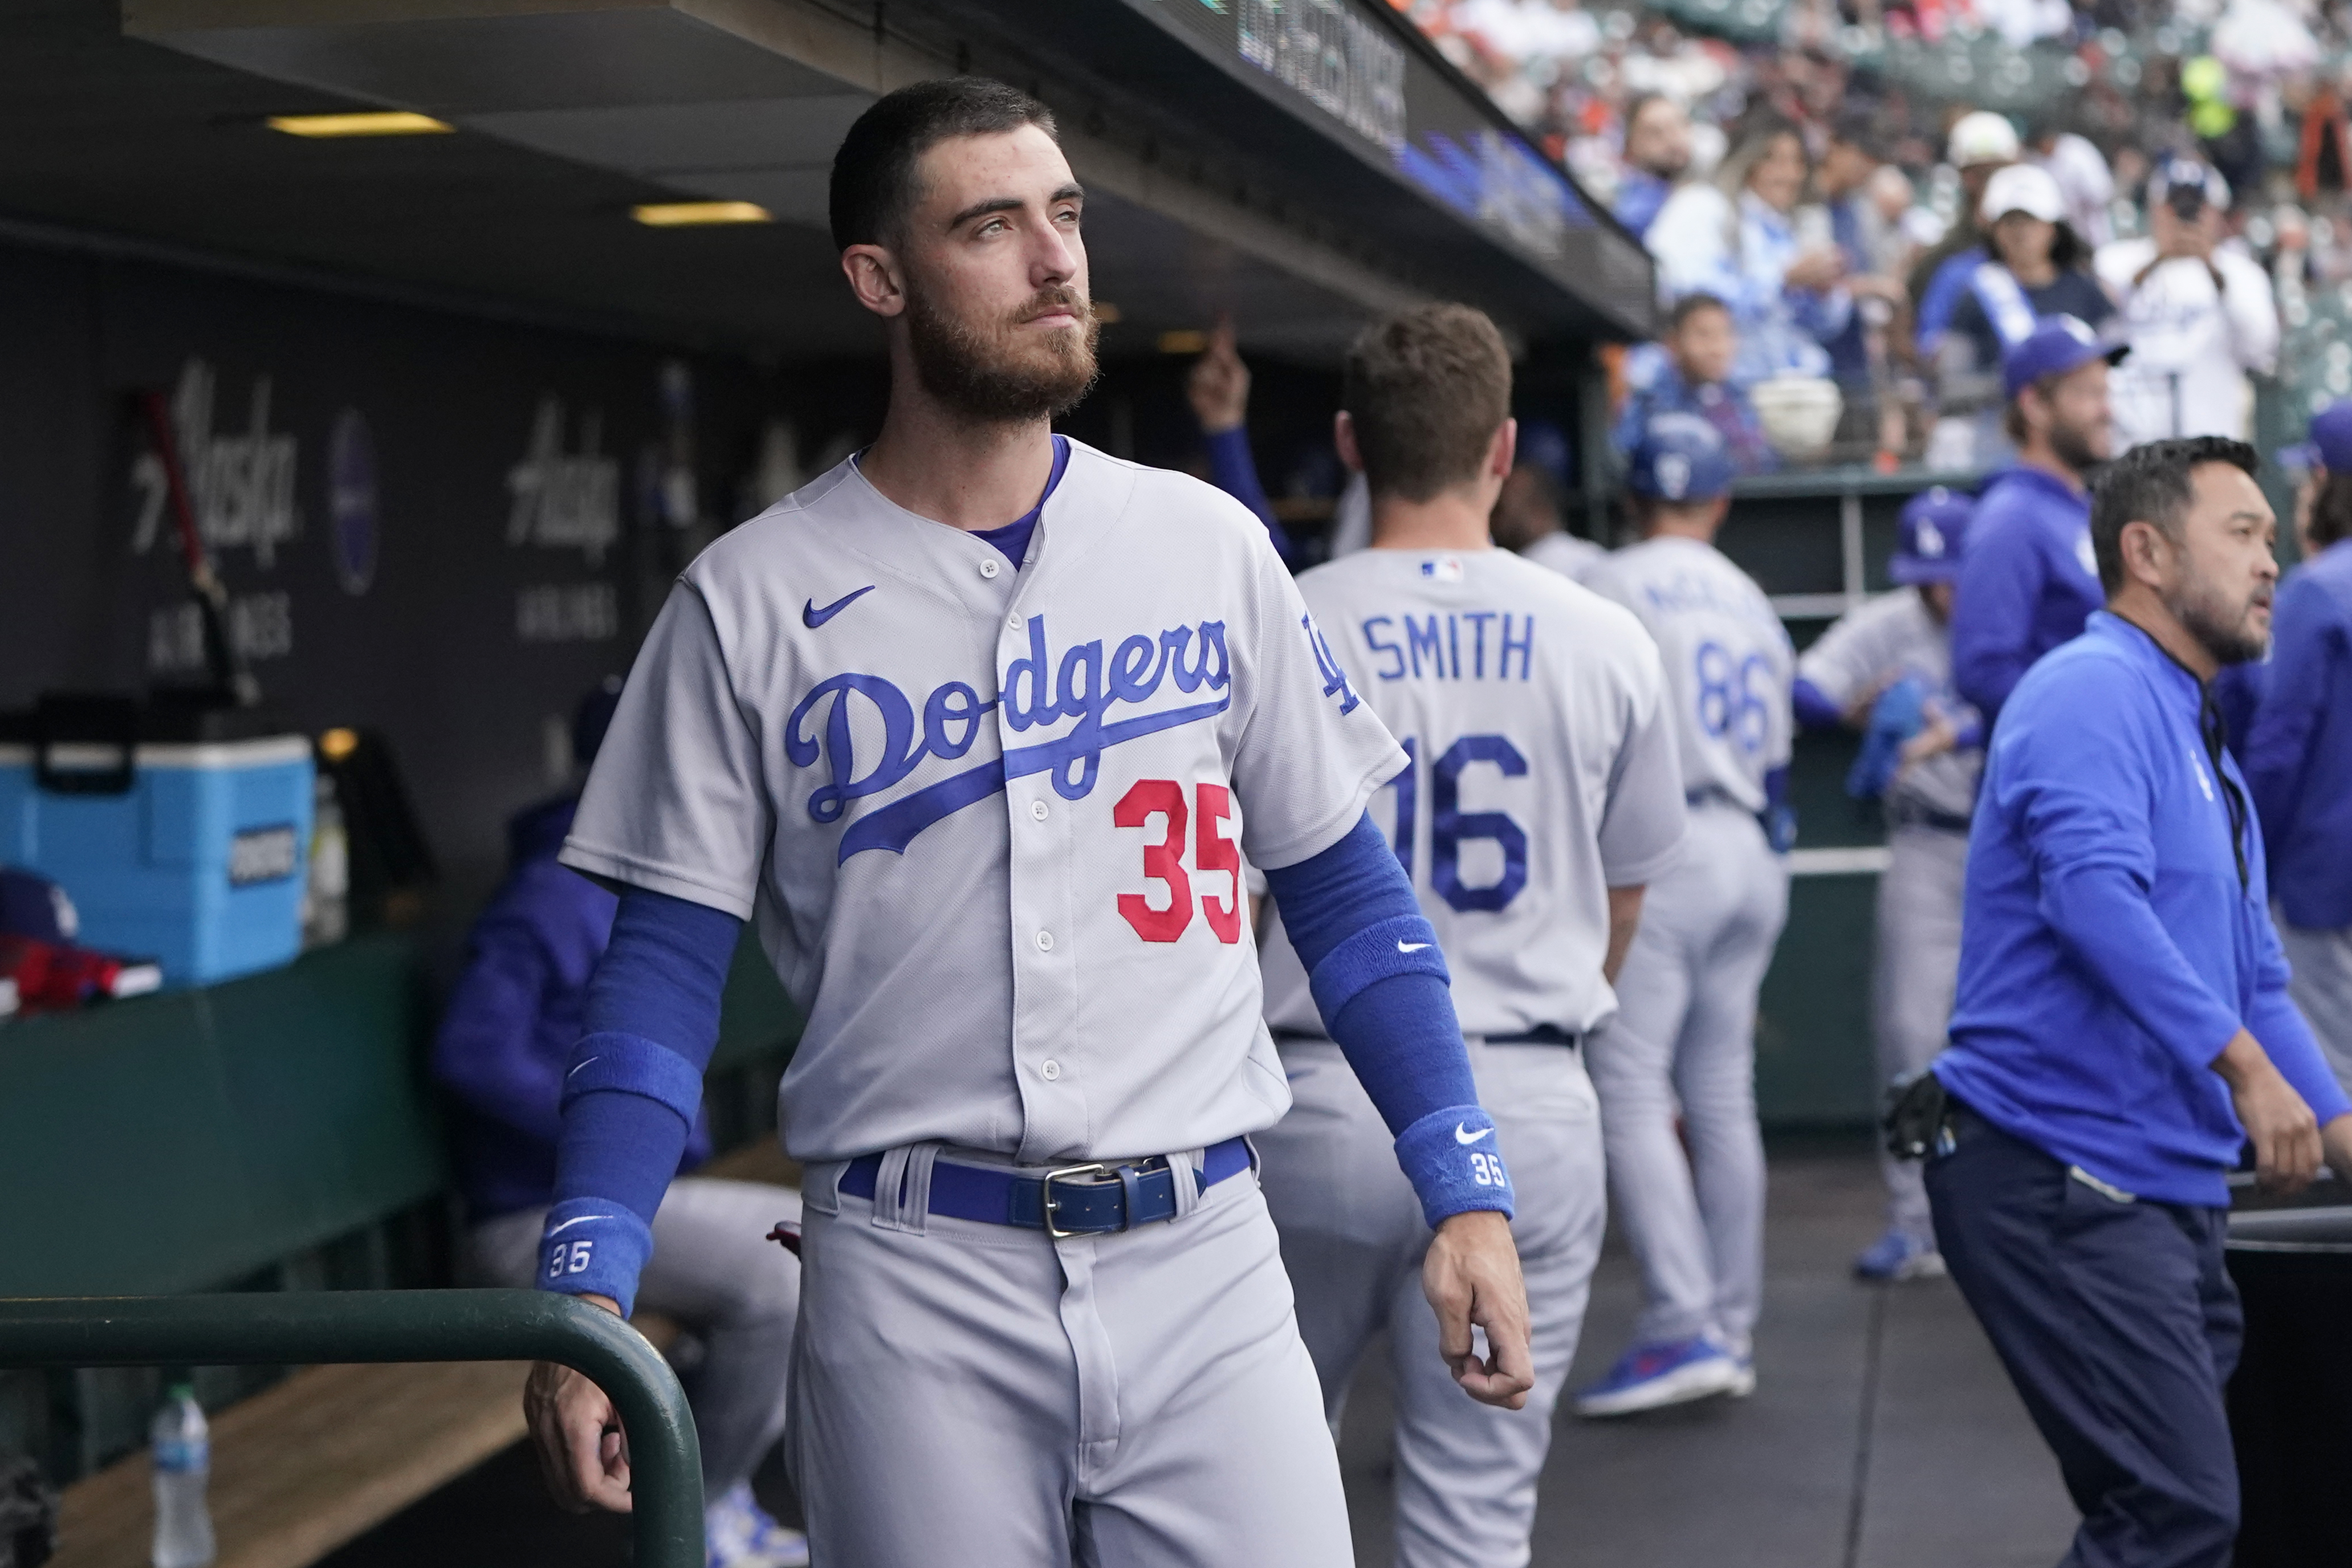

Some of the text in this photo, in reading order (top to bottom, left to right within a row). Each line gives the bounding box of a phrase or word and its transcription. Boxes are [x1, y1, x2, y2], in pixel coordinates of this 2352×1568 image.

[1361, 609, 1535, 682] SMITH
[1696, 637, 1777, 756] 86
[786, 613, 1230, 824] Dodgers
[1113, 779, 1241, 944] 35
[1383, 732, 1530, 913] 16
[1471, 1152, 1506, 1188] 35
[549, 1240, 593, 1278] 35
